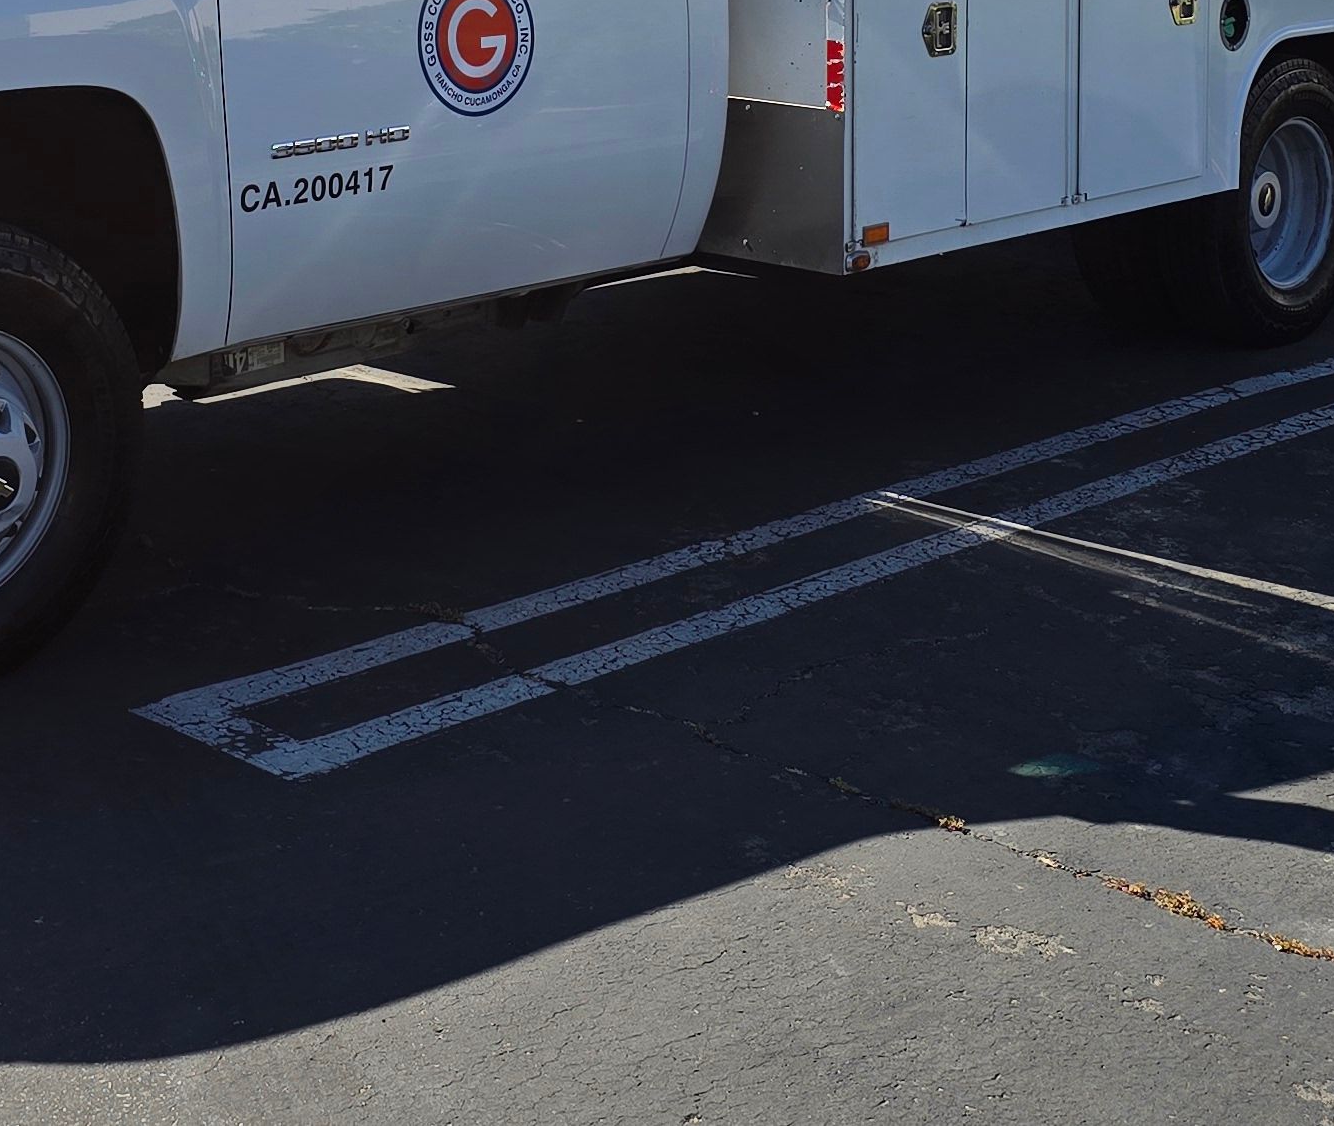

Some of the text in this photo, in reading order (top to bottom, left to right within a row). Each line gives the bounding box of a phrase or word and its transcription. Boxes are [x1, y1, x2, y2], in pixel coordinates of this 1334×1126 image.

[424, 20, 437, 67] GOSS
[517, 26, 529, 57] INC.
[434, 63, 522, 106] RANCHO CUCAMONGA, CA
[270, 124, 410, 160] 3500 HD
[240, 164, 394, 213] CA.200417
